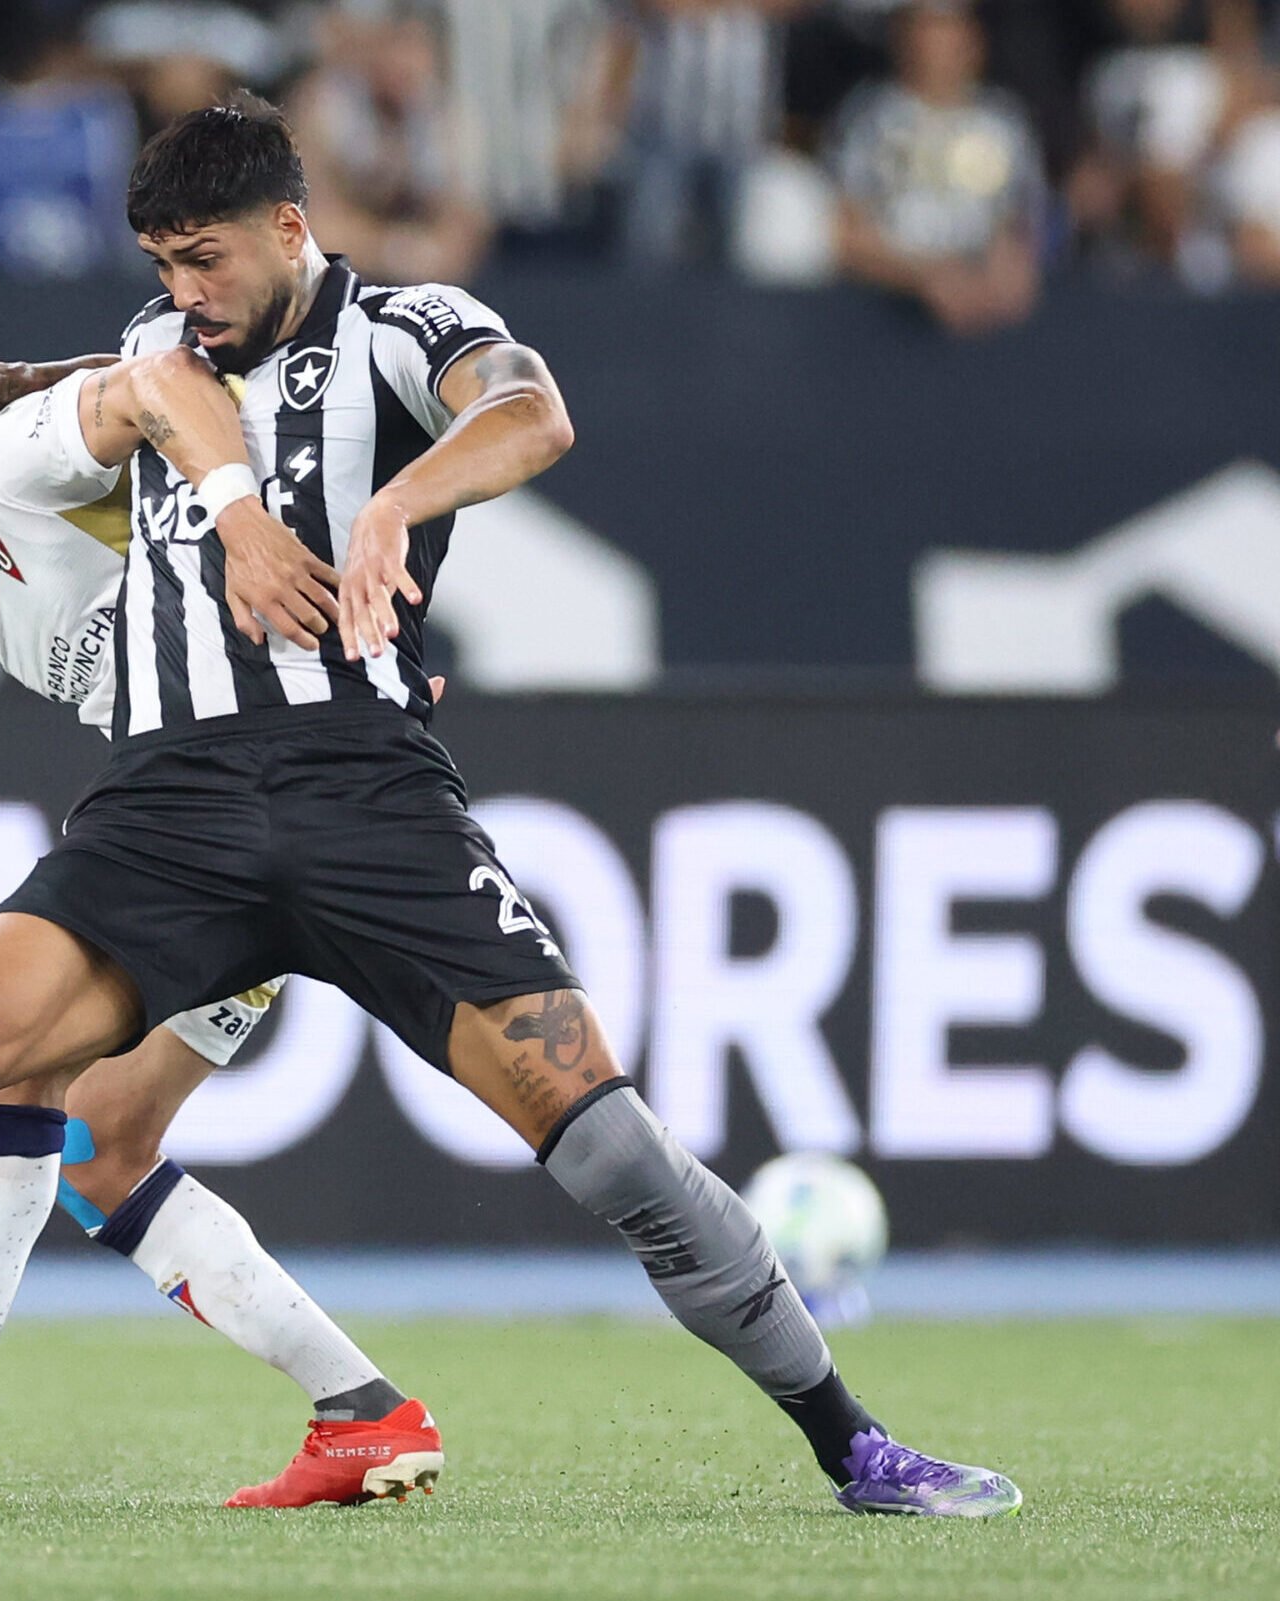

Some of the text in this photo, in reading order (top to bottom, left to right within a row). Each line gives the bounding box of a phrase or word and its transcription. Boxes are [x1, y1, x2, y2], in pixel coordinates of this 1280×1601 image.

[141, 479, 297, 541] vbt
[47, 635, 71, 694] BANCO
[468, 865, 550, 935] 2
[325, 1446, 392, 1458] NEMESIS
